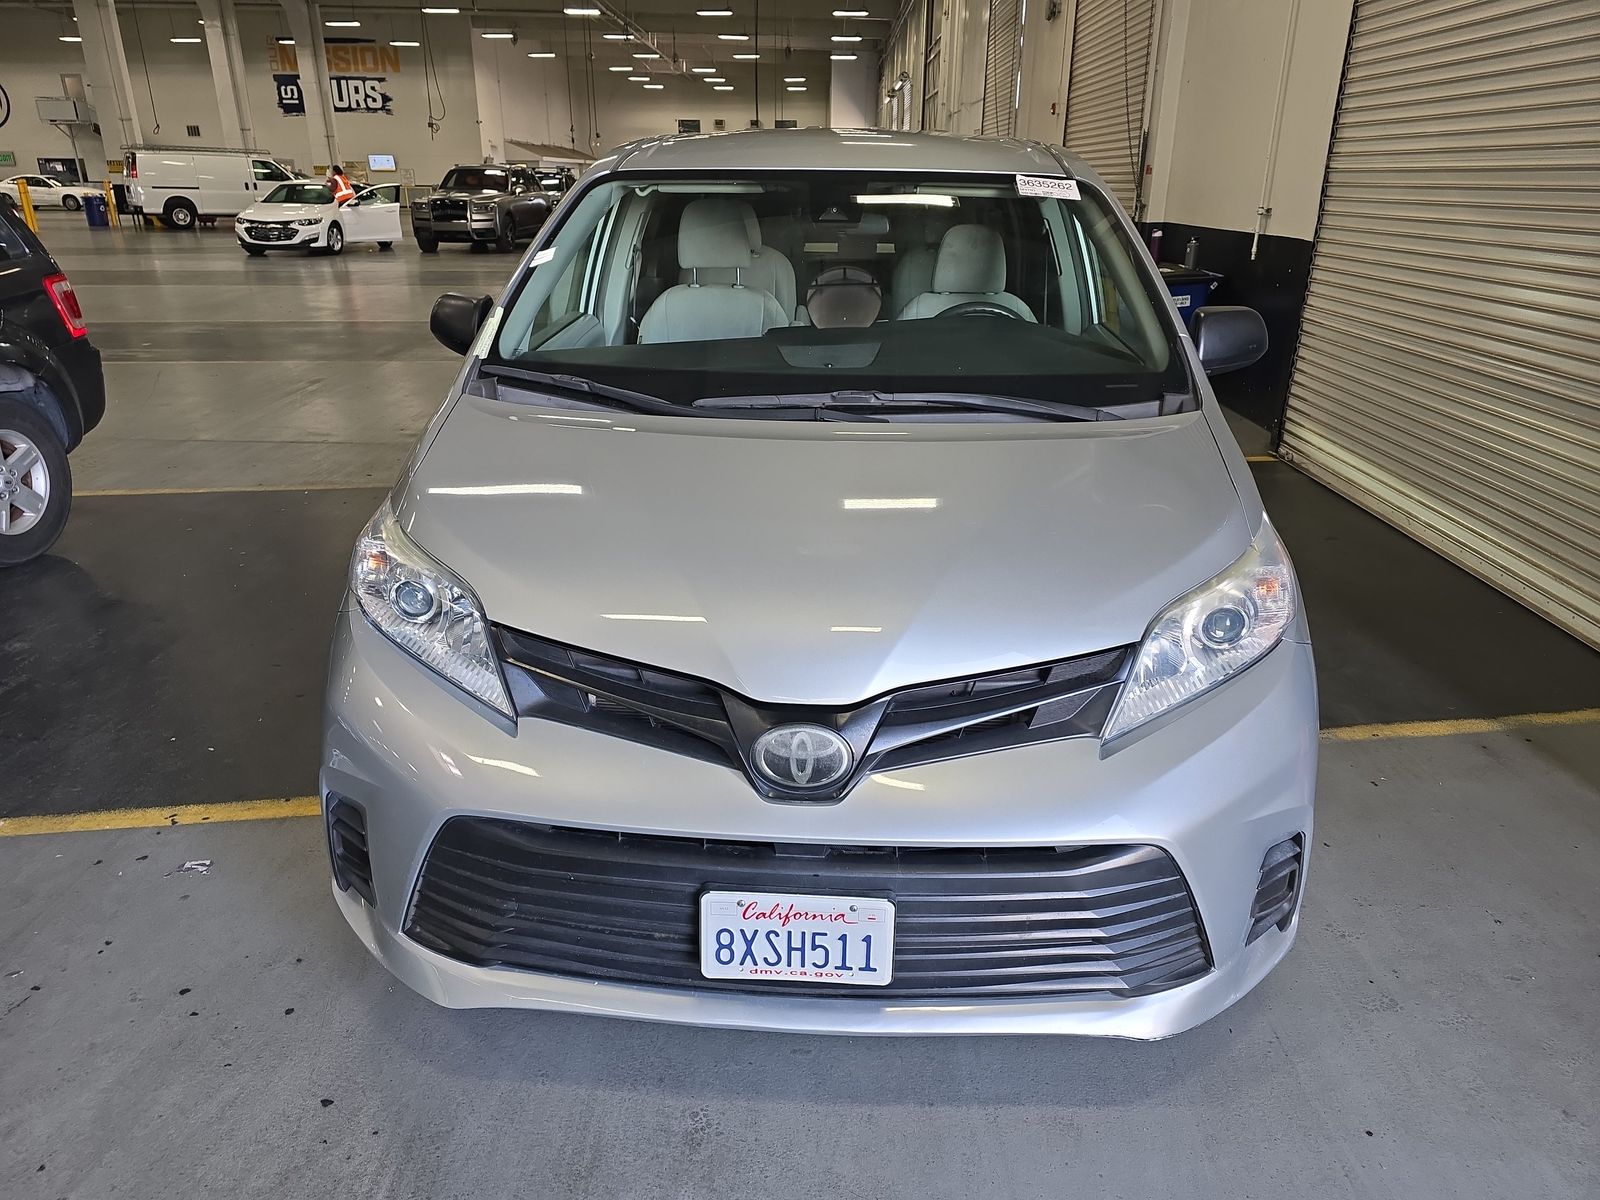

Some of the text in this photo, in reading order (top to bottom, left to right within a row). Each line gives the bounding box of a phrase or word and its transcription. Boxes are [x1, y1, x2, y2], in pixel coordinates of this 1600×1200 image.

[266, 35, 279, 72] OUR
[279, 46, 401, 73] MSION
[281, 85, 299, 104] IS
[1019, 178, 1072, 191] 3635262
[742, 901, 858, 927] California
[715, 928, 877, 972] 8XSH511
[749, 968, 844, 978] dmv.ca.gov
